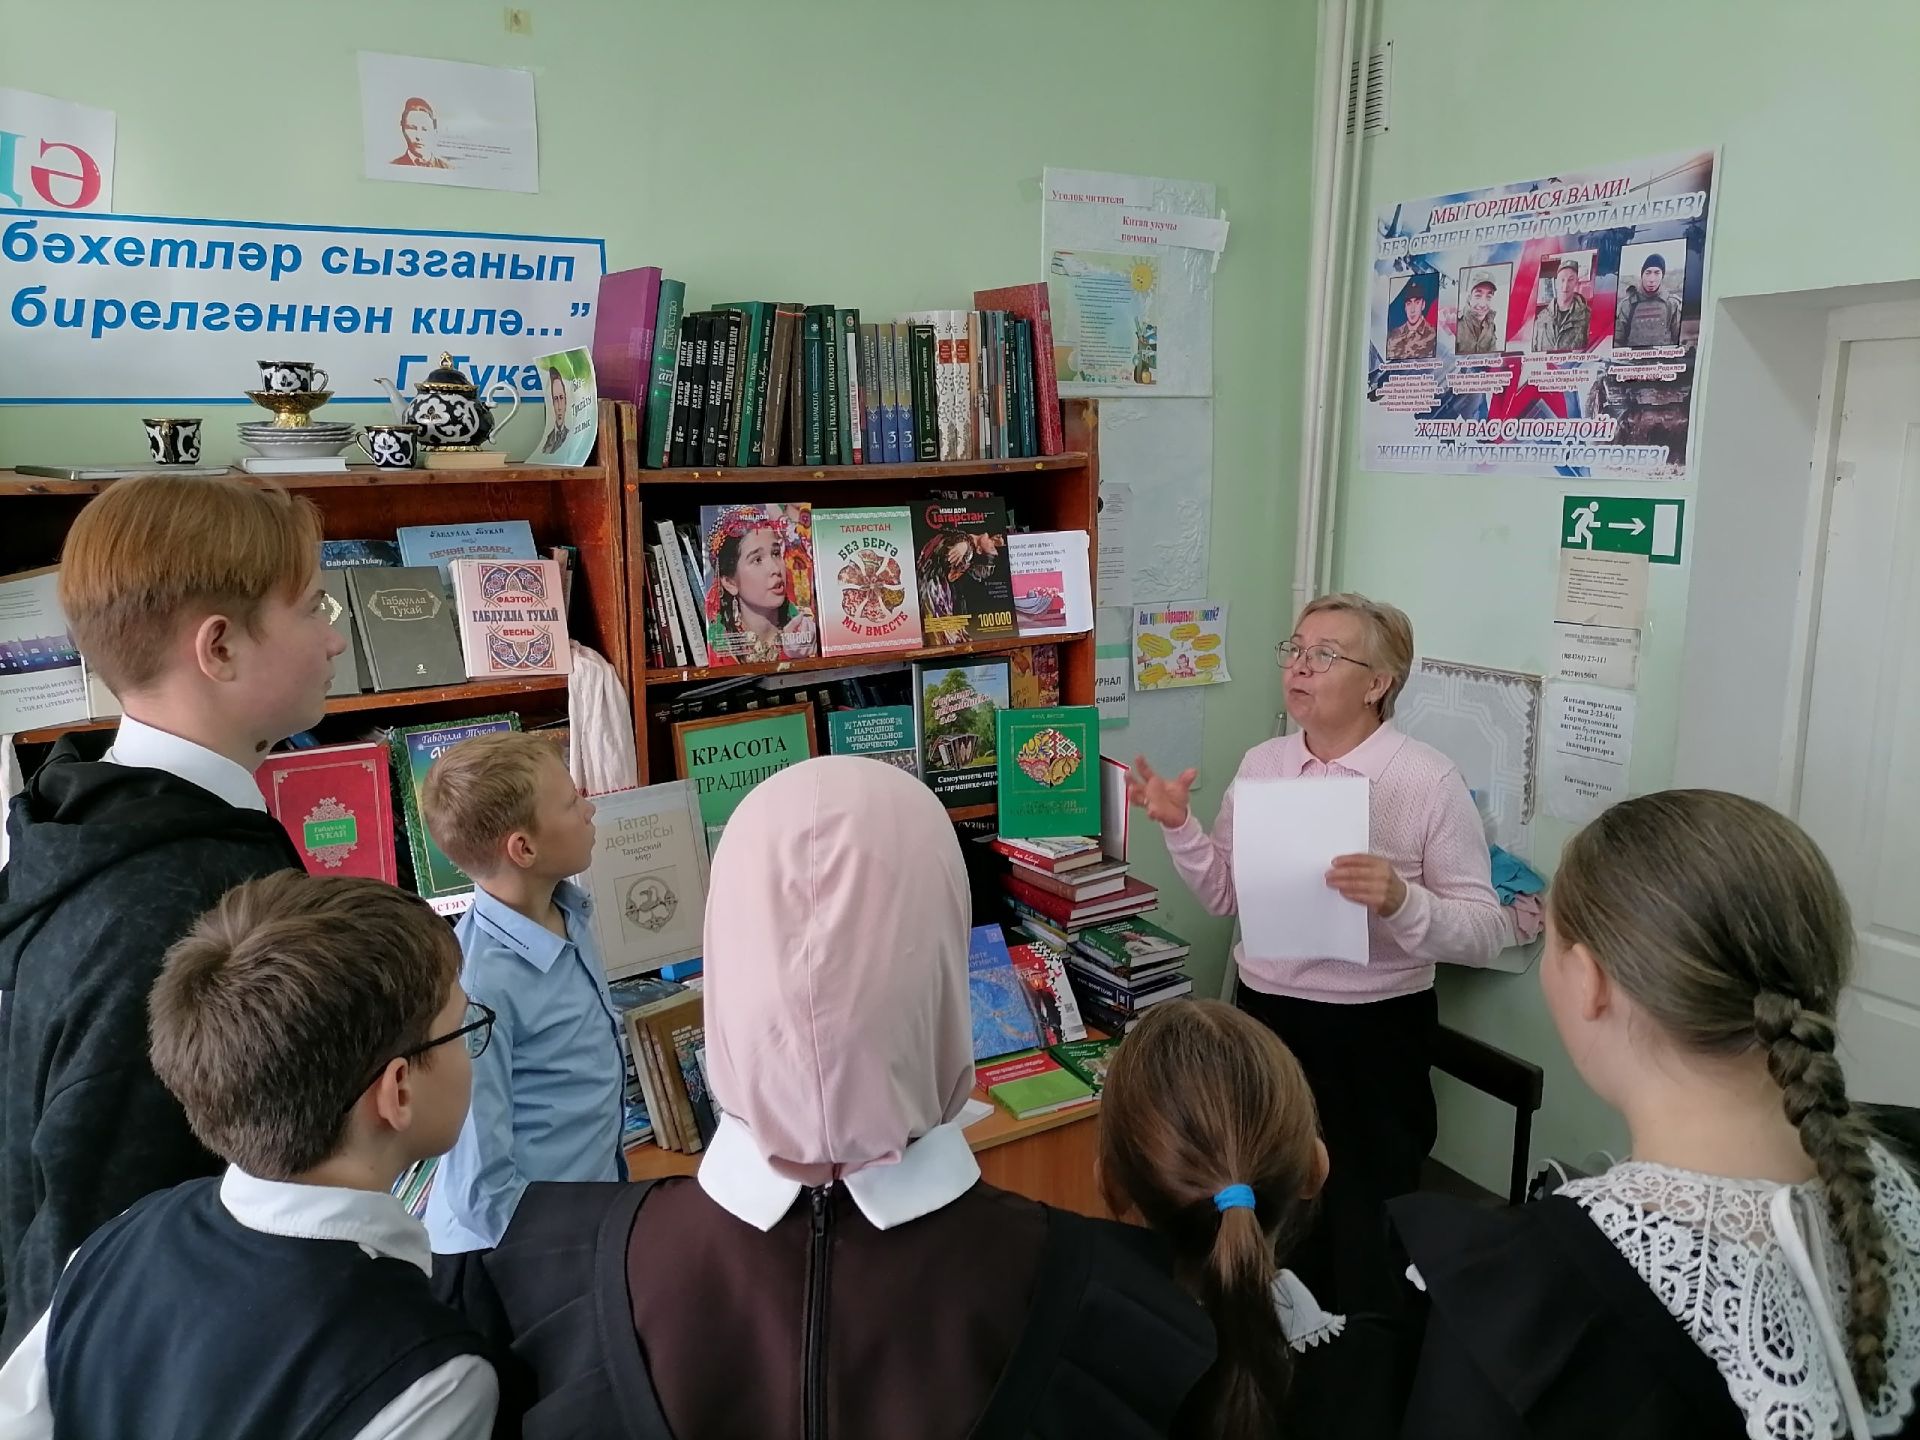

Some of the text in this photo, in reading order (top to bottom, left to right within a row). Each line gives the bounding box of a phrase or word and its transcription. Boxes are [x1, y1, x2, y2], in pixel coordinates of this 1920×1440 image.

[1052, 190, 1124, 204] Уголок читателя
[1431, 178, 1631, 226] МЫ ГОРДИМСЯ ВАМИ!
[1122, 216, 1177, 231] Китап укучы
[1, 220, 575, 283] бәхетләр сызганып
[11, 286, 393, 338] бирелгәннән
[695, 340, 703, 365] КНИГА
[712, 340, 720, 366] КНИГА
[828, 346, 836, 390] ШАКИРОВ
[1415, 421, 1462, 439] ЖДЕМ
[1468, 421, 1500, 438] ВАС
[1518, 416, 1615, 439] ПОБЕДОЙ!
[888, 431, 897, 444] 3
[904, 430, 912, 444] 3
[840, 523, 891, 533] ТАТАРСТАН
[838, 540, 860, 561] БЕЗ
[326, 557, 383, 567] Gabdulla Tukay
[381, 595, 427, 608] Габдулла
[497, 596, 533, 604] ФАЭТОН
[390, 605, 422, 617] Тукай
[473, 608, 559, 624] ГАБДУЛЛА ТУКАЙ
[842, 616, 862, 634] МЫ
[978, 613, 994, 627] 100
[995, 611, 1012, 626] 000
[503, 628, 535, 636] ВЕСНЫ
[852, 717, 895, 728] ТАТАРСКОЕ
[854, 725, 895, 735] НАРОДНОЕ
[422, 726, 497, 744] Габдулла Тукай
[845, 732, 903, 744] МУЗЫКАЛЬНОЕ
[691, 736, 787, 766] КРАСОТА
[851, 739, 898, 751] ТВОРЧЕСТВО
[938, 773, 982, 783] Самоучитель
[614, 813, 659, 831] Татар
[622, 841, 662, 856] Татарский
[635, 853, 651, 862] мир
